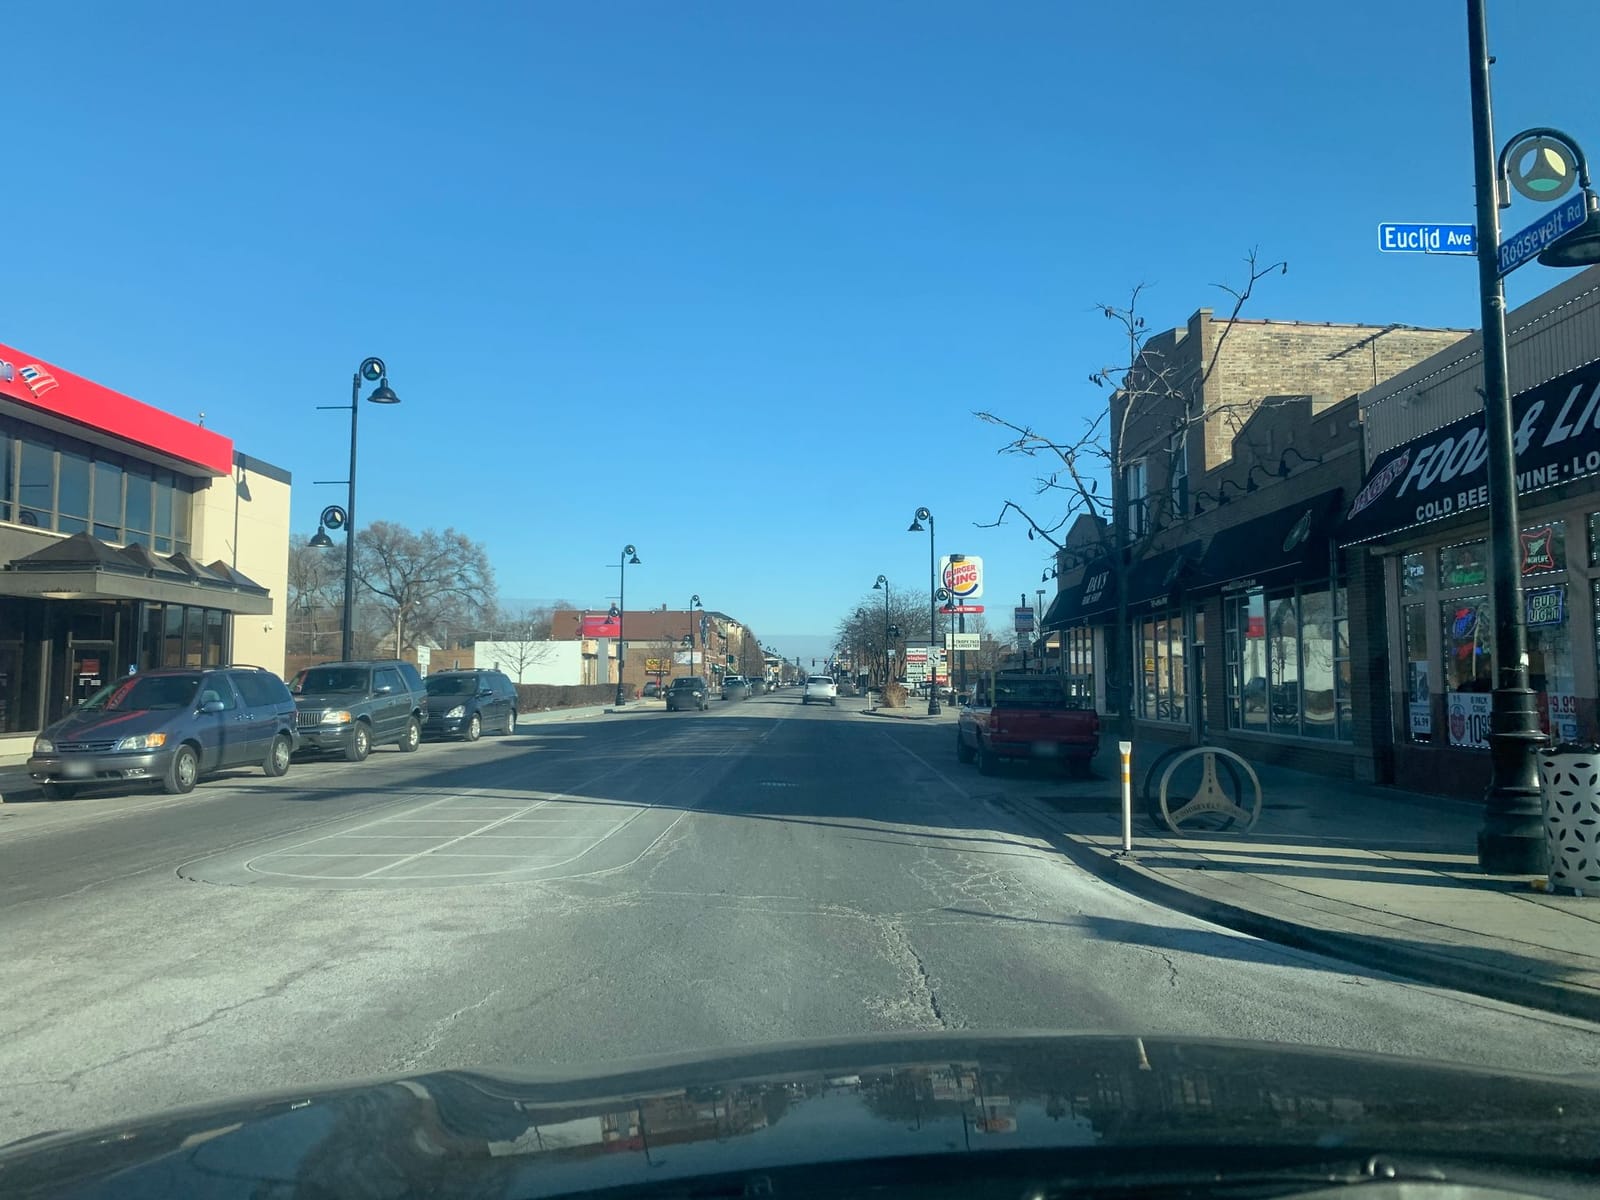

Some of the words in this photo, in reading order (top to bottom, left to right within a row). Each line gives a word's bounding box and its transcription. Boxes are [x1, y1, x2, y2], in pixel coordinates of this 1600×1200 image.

[1384, 227, 1440, 248] Euclid
[1447, 231, 1471, 245] Ave
[1501, 210, 1564, 268] Roosevelt
[1567, 202, 1581, 223] Rd
[1396, 426, 1489, 498] FOOD
[1513, 400, 1546, 457] &
[1541, 381, 1600, 448] LI
[1416, 497, 1453, 521] COLD
[1457, 485, 1488, 509] BEE
[946, 564, 976, 579] BURGER
[947, 572, 977, 588] KING
[1533, 594, 1557, 609] BUD
[1529, 606, 1560, 622] LIGHT
